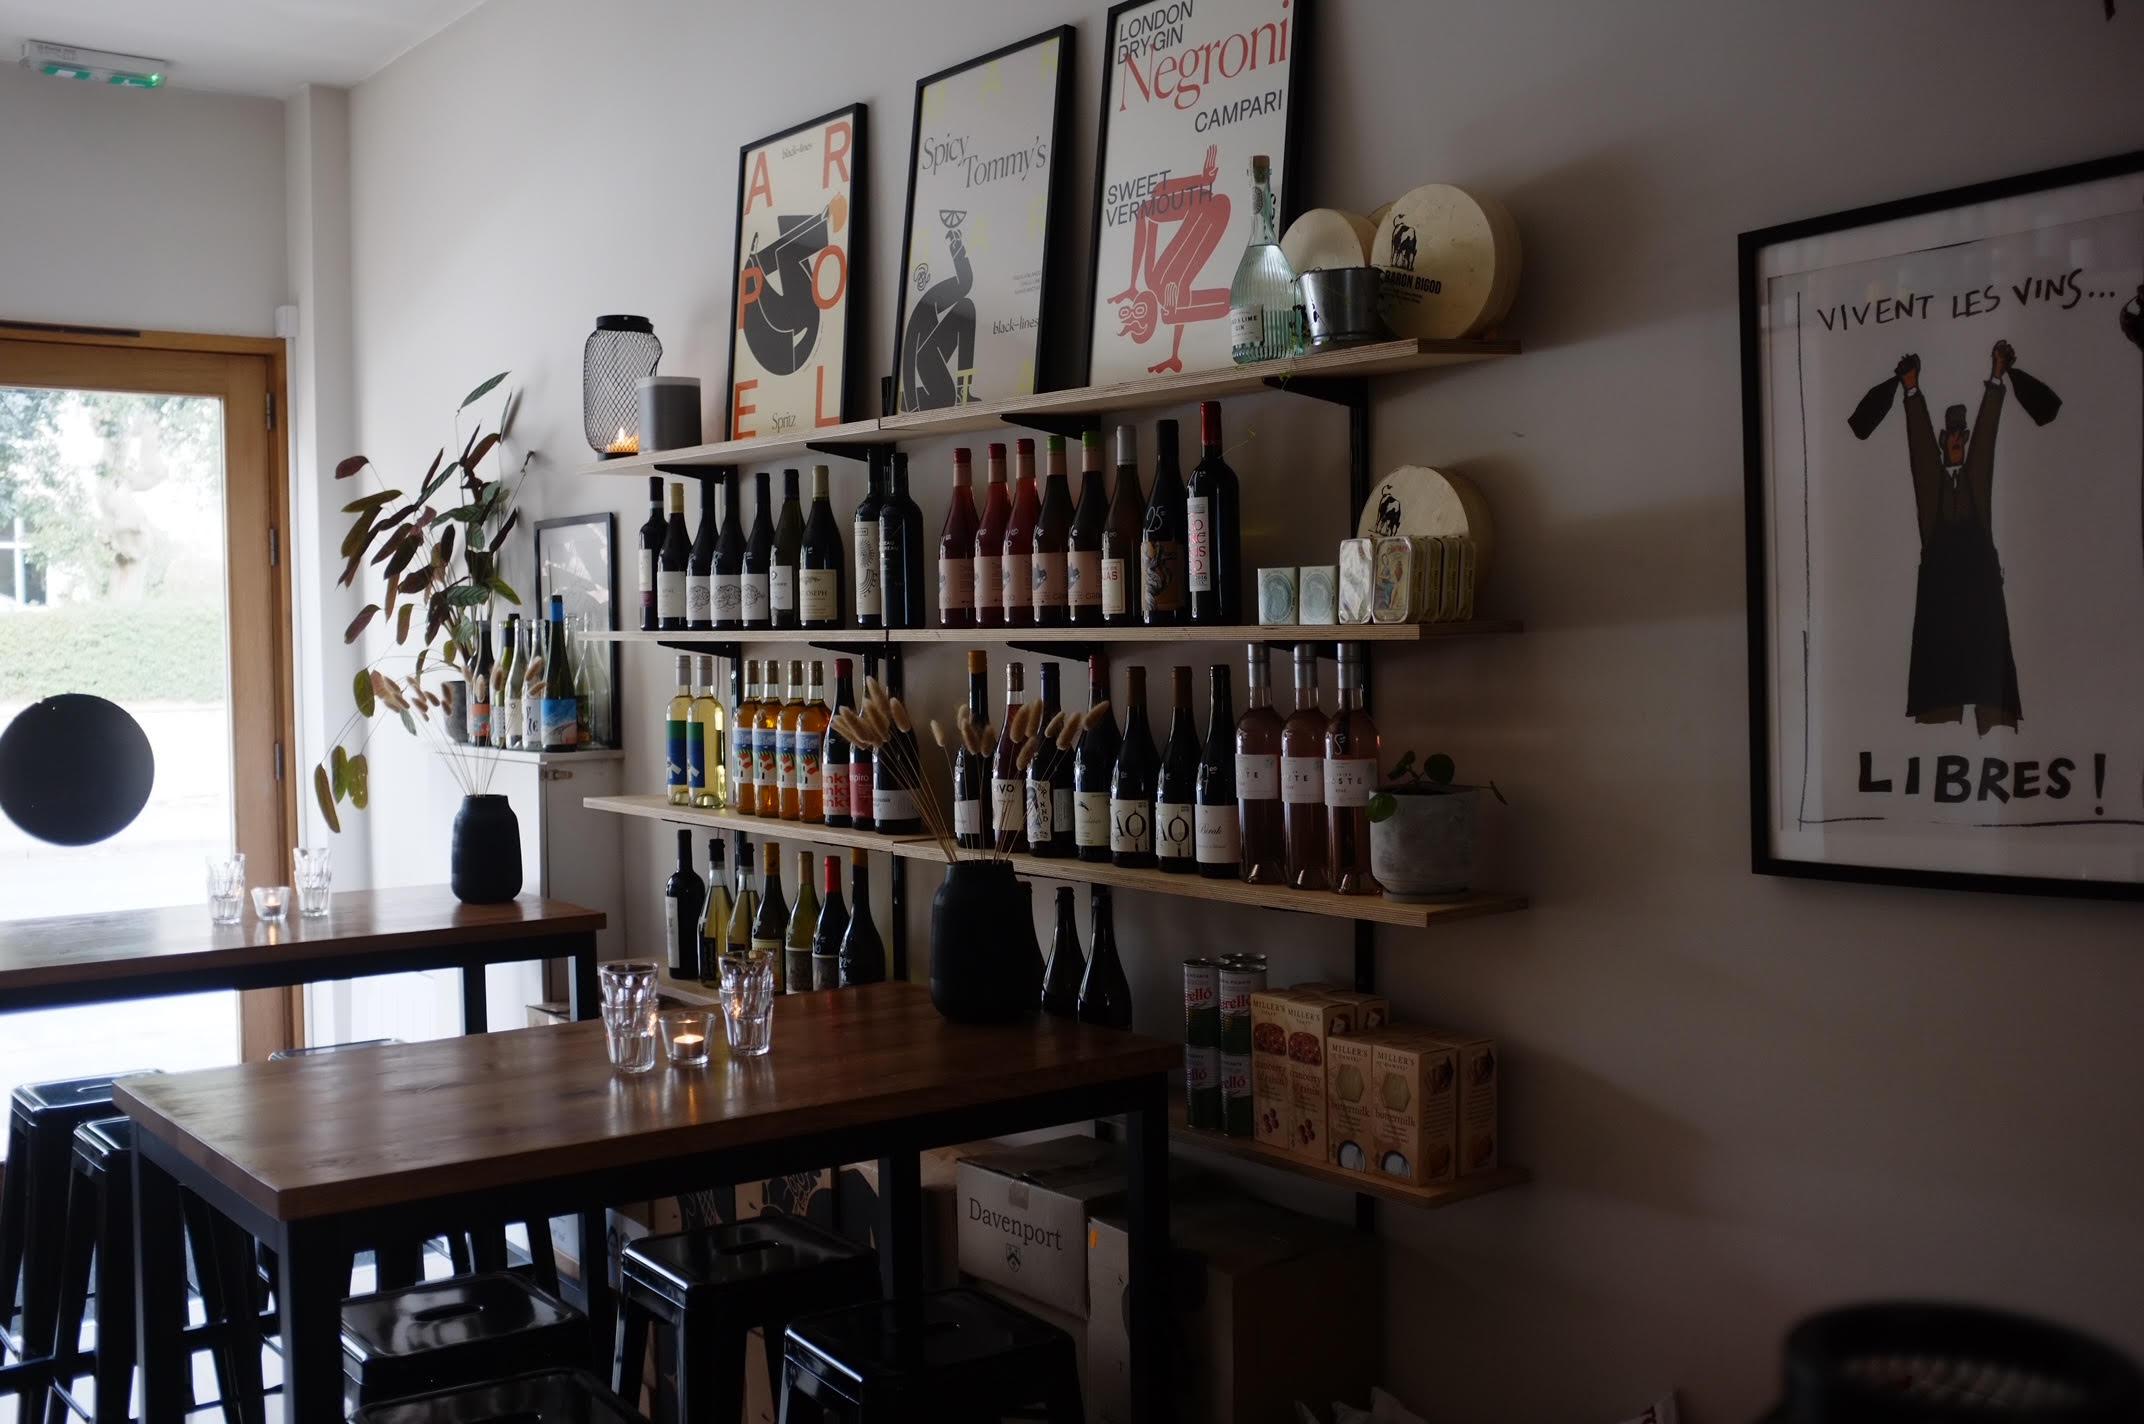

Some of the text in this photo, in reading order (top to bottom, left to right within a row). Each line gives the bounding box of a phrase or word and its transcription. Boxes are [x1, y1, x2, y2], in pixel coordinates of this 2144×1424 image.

[1120, 0, 1194, 43] LONDON
[1117, 24, 1184, 65] DRY GIN
[1119, 0, 1290, 112] Negroni
[1194, 89, 1283, 133] CAMPARI
[922, 133, 970, 175] Spicy
[962, 135, 1047, 188] Tommy's
[1105, 183, 1213, 228] VERMOUTH
[1107, 169, 1171, 205] SWEET
[1415, 276, 1442, 294] BIGOD
[1817, 293, 1935, 332] VIVENT
[1951, 284, 2001, 320] LES
[771, 411, 797, 433] Spritz
[1287, 1007, 1321, 1022] MILLER'S
[1332, 1044, 1368, 1057] MILLER'S
[1376, 1051, 1416, 1066] MILLER'S
[969, 1198, 1064, 1251] Davenport
